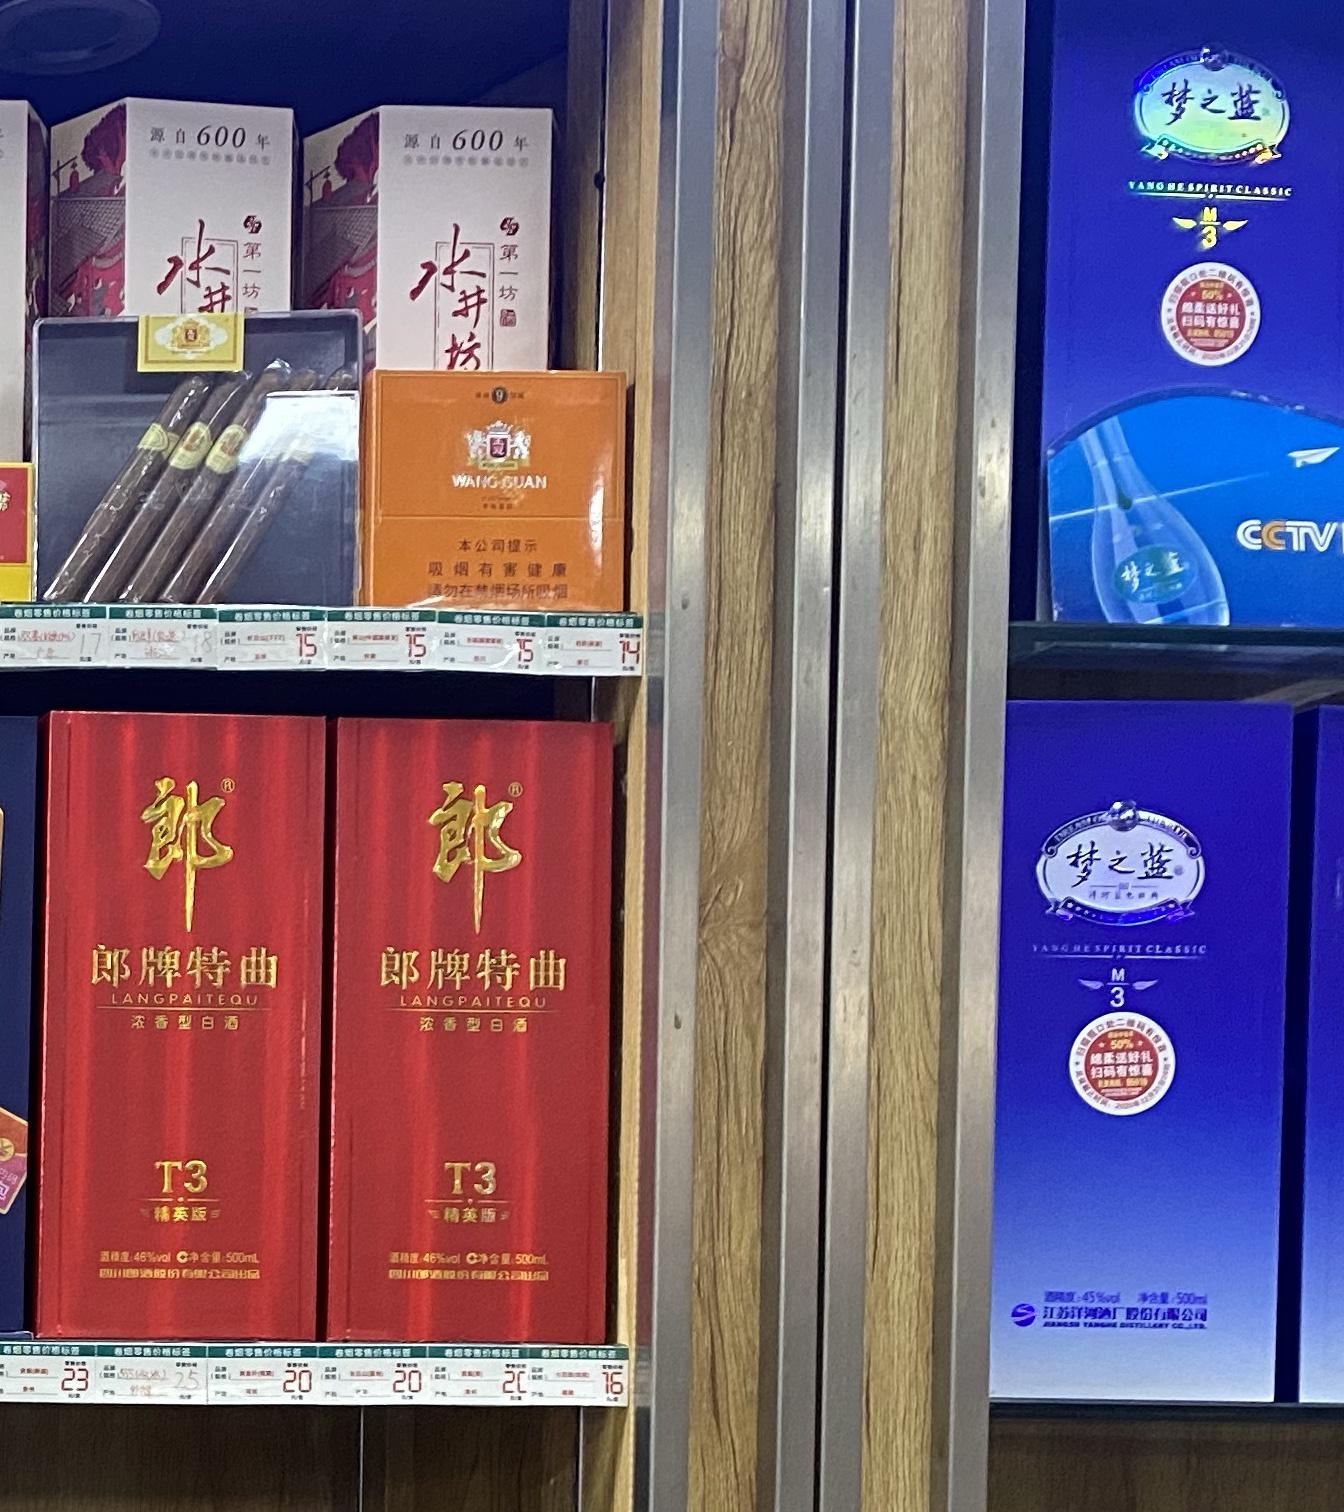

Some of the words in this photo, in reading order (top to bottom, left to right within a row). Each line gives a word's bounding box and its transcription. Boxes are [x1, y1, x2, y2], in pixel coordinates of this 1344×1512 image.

[1160, 79, 1263, 126] 梦之蓝
[1203, 207, 1218, 224] M
[1201, 226, 1218, 248] 3
[452, 474, 498, 490] WANG
[501, 474, 547, 490] GUAN
[458, 538, 538, 552] 本公司提示
[1236, 519, 1341, 552] CCTV
[428, 561, 567, 579] 吸烟有害健康
[296, 634, 318, 658] 15
[405, 634, 427, 658] 15
[619, 640, 641, 664] 14
[140, 776, 235, 933] 郎
[428, 781, 522, 936] 郎
[1066, 840, 1175, 889] 梦之蓝
[1111, 968, 1125, 982] M
[112, 992, 259, 1006] LANGPAITEQU
[1110, 986, 1125, 1008] 3
[130, 1015, 240, 1031] 浓香型白酒
[1090, 1051, 1154, 1064] 绵柔送好礼
[1091, 1064, 1153, 1079] 扫码有惊喜
[154, 1159, 209, 1195] T3
[153, 1205, 208, 1223] 精英版
[62, 1368, 89, 1391] 23
[283, 1370, 312, 1393] 20
[393, 1370, 422, 1393] 20
[602, 1371, 624, 1395] 16
